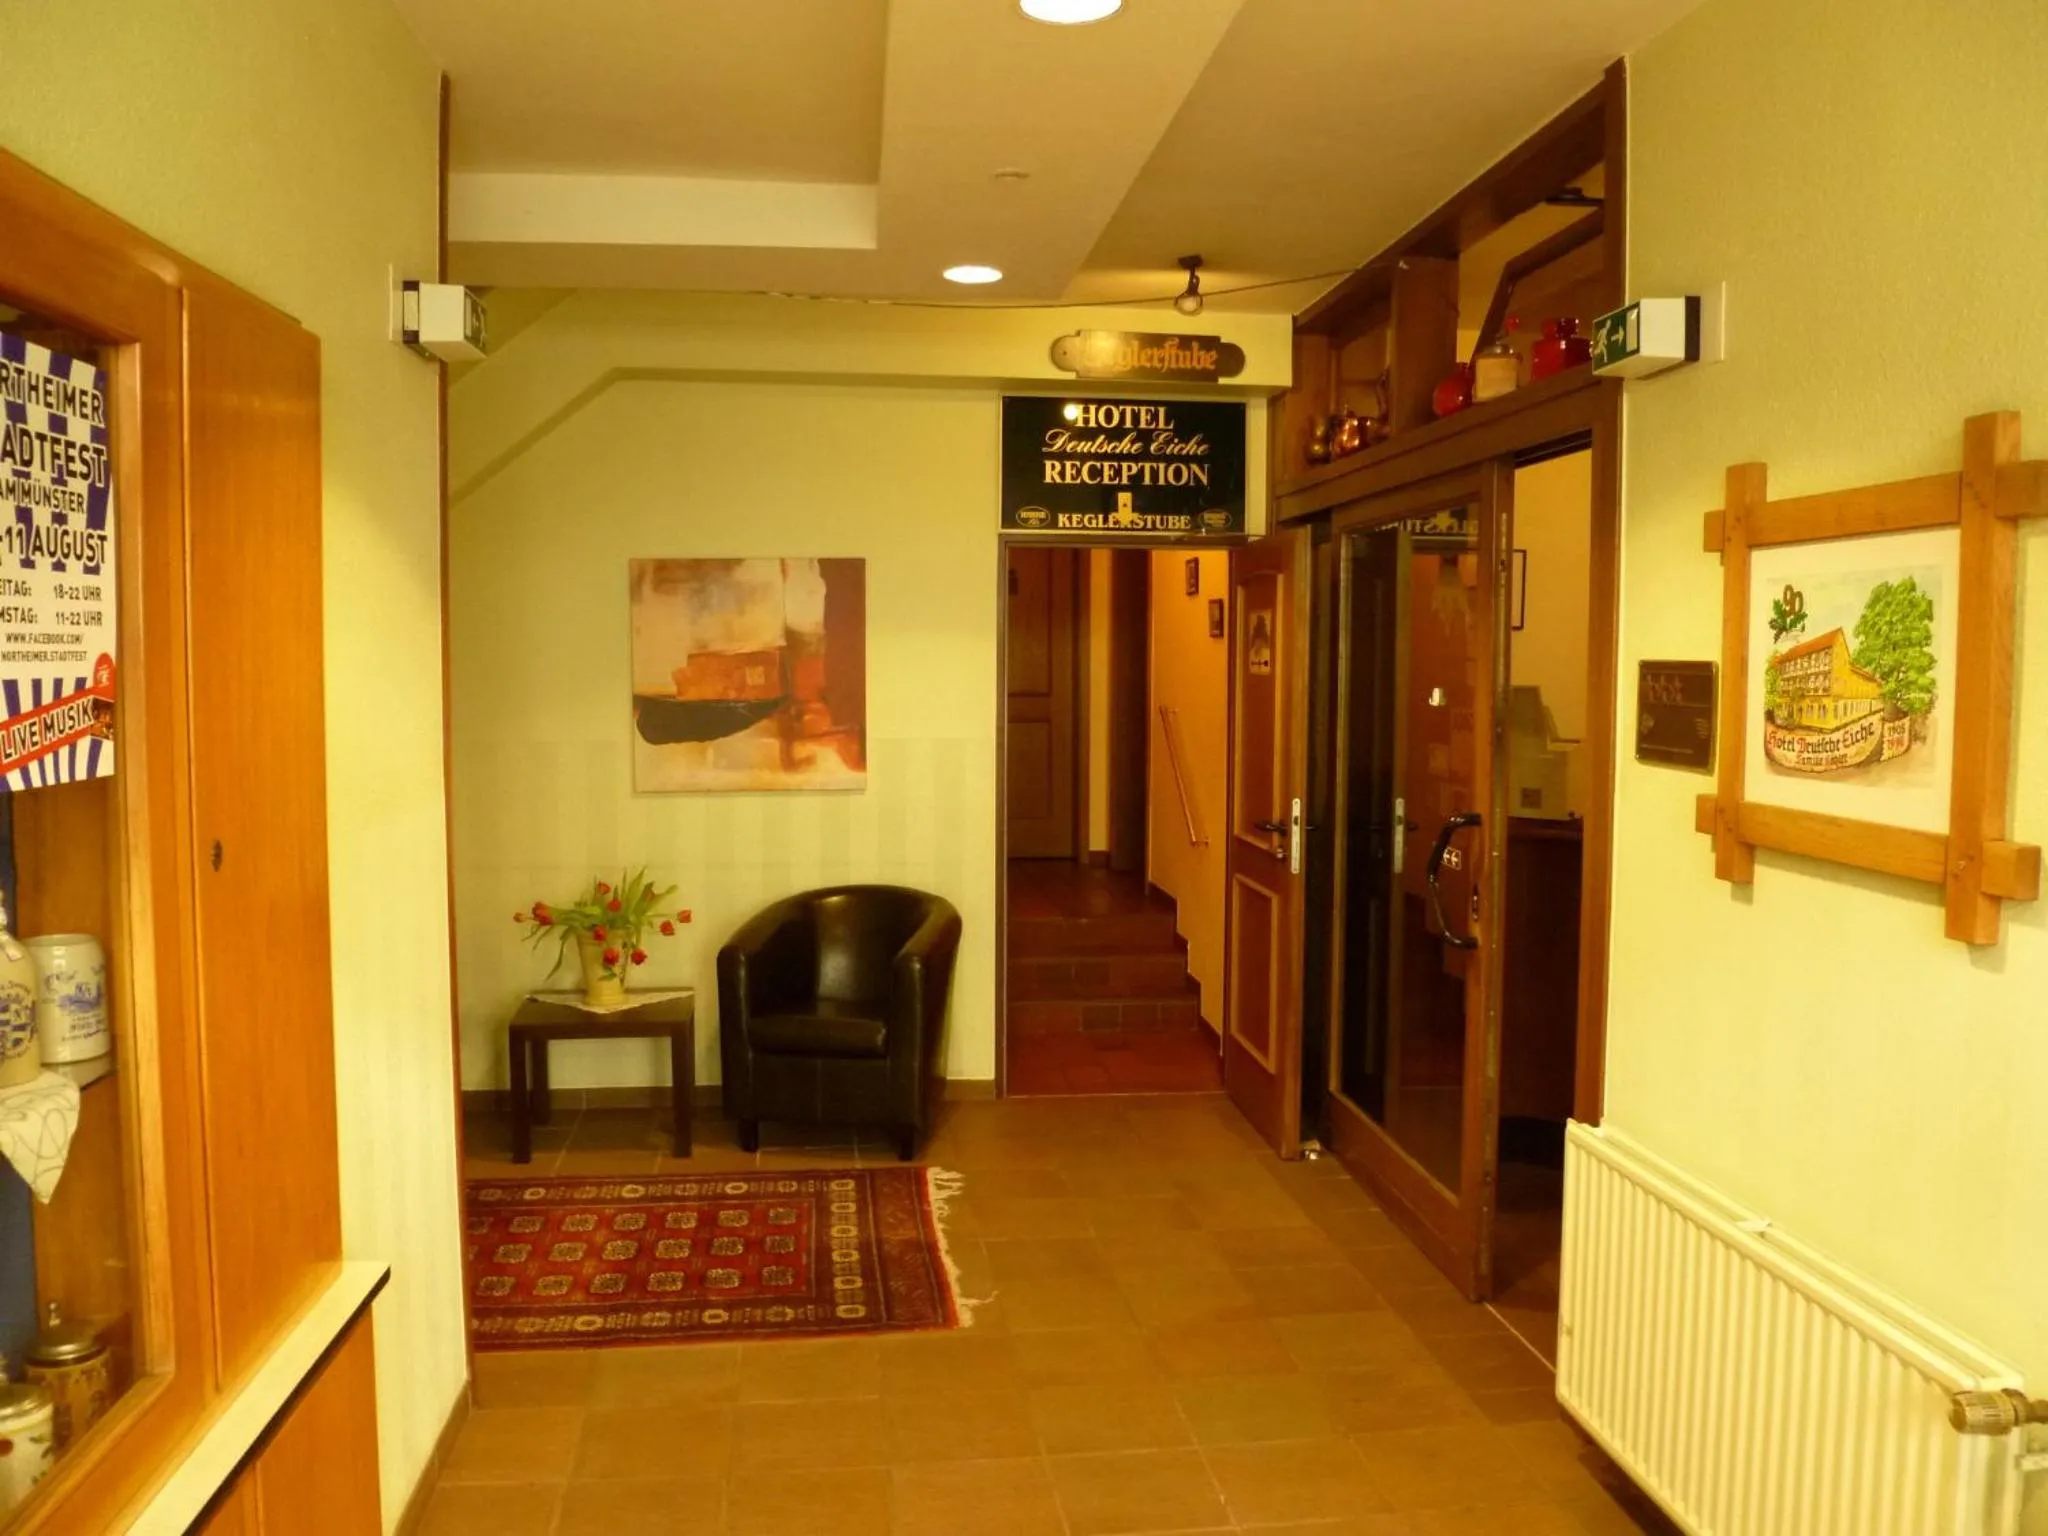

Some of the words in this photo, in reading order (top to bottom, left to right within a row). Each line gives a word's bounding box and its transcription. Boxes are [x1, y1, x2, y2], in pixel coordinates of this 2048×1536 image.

[0, 361, 103, 424] RTHEIMER
[1074, 404, 1174, 430] HOTEL
[0, 422, 105, 484] ADTFEST
[1042, 429, 1145, 455] Deutsche
[1150, 431, 1210, 456] Eiche
[1043, 460, 1209, 486] RECEPTION
[21, 479, 85, 513] MÜNSTER
[31, 524, 108, 564] AUGUST
[53, 583, 80, 601] 18-22
[82, 585, 102, 601] UHR
[55, 611, 81, 626] 11-22
[83, 611, 103, 626] UHR
[1, 721, 39, 760] LIVE
[41, 697, 95, 745] MUSIK
[1842, 721, 1875, 749] Eiche
